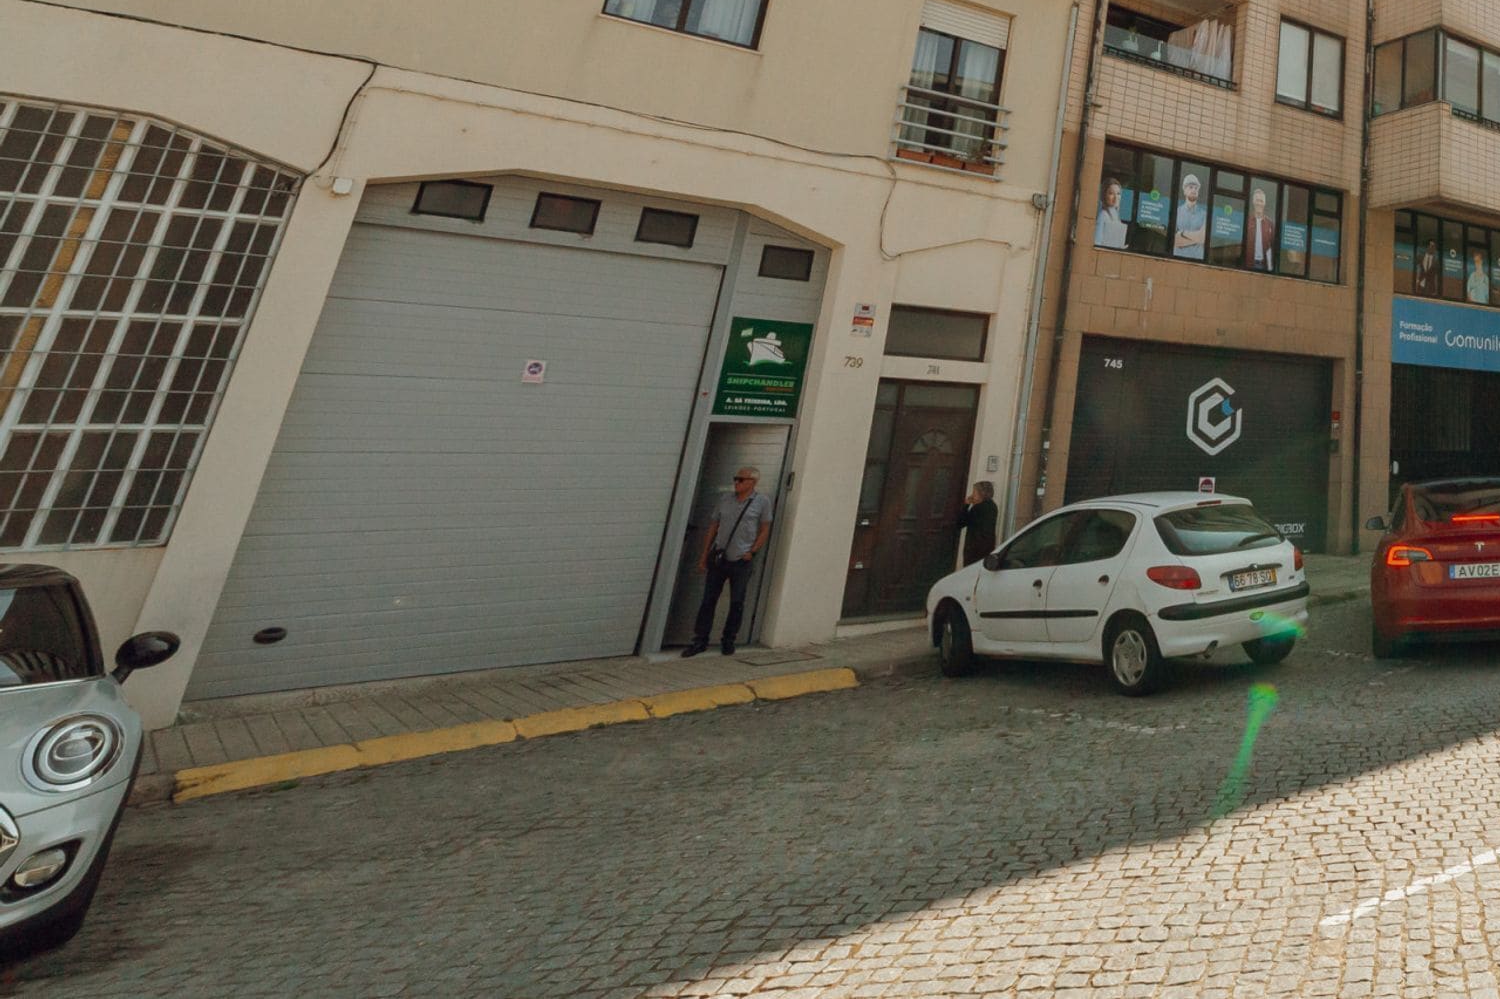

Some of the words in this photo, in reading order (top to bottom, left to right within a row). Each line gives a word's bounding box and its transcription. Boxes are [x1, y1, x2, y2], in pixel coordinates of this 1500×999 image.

[1400, 320, 1433, 332] Formação
[1399, 332, 1438, 344] Profissional
[843, 356, 864, 368] 739
[1103, 358, 1123, 369] 745
[726, 376, 795, 388] SHIPCHANDLER
